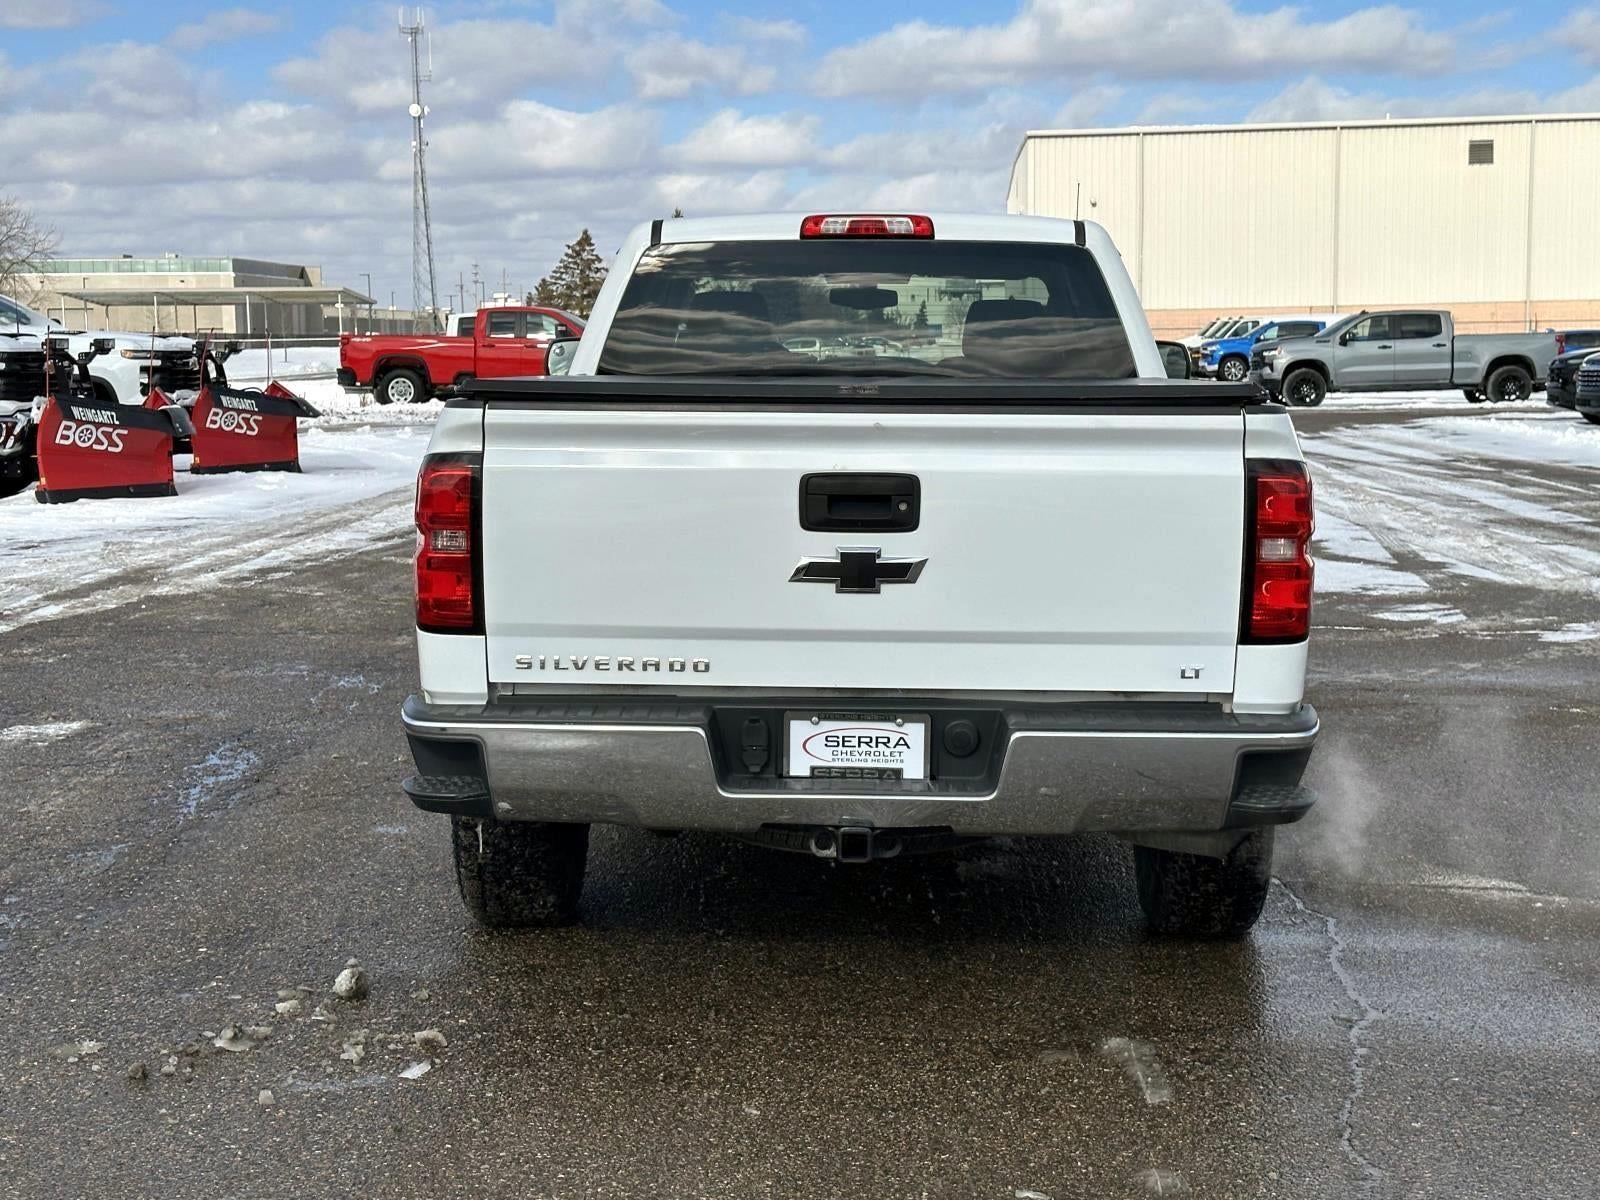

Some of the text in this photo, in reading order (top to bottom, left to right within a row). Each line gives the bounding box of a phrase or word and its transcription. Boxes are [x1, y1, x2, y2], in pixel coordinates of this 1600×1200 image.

[219, 394, 259, 412] WEINGARTZ
[70, 405, 120, 425] WEINGARTZ
[205, 407, 263, 436] BOSS
[54, 420, 128, 453] BOSS
[515, 654, 711, 673] SILVERADO
[1180, 664, 1205, 679] LT
[824, 735, 911, 749] SERRA
